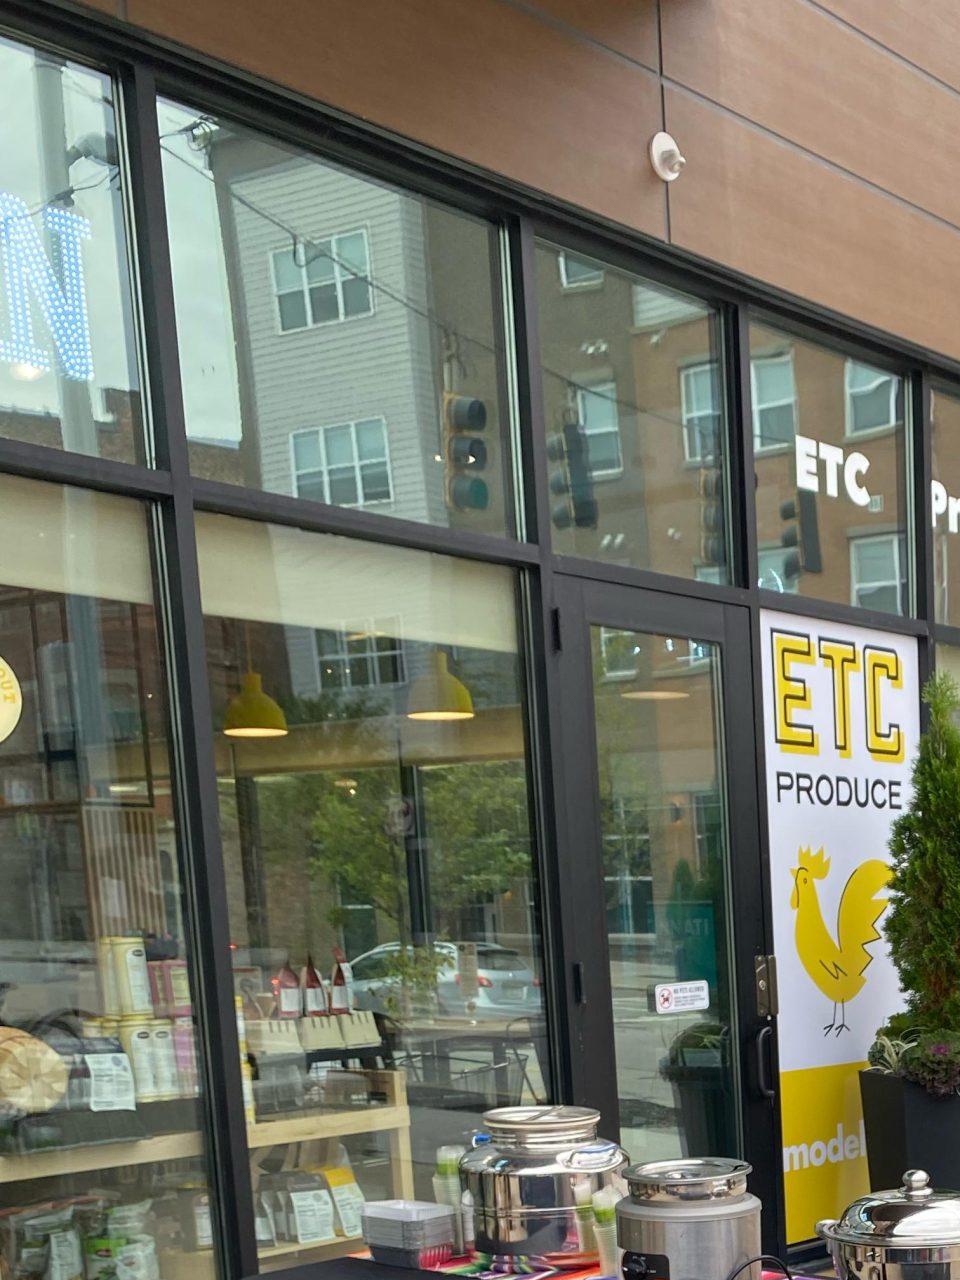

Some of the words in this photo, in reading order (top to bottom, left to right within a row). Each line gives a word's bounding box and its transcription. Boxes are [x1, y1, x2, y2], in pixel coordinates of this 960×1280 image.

[795, 434, 871, 506] ETC
[770, 628, 905, 763] ETC
[776, 771, 903, 810] PRODUCE
[782, 1119, 867, 1173] model
